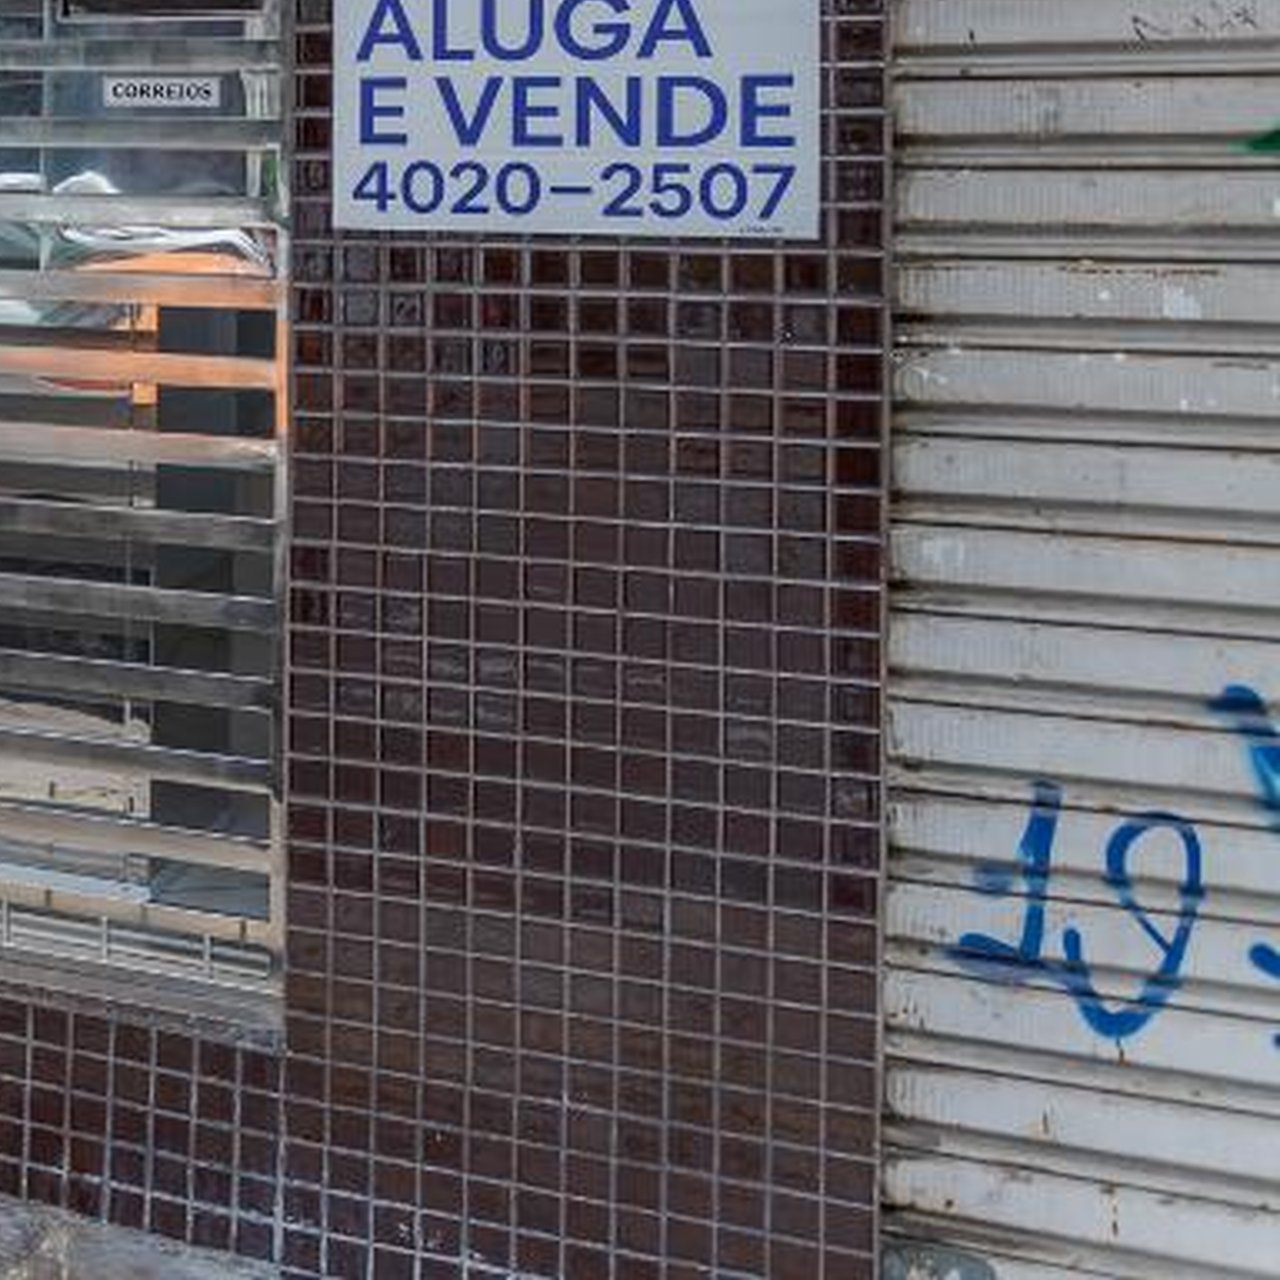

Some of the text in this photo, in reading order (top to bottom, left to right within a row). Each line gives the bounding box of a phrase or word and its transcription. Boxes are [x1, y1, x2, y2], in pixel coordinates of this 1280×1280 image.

[111, 81, 213, 101] CORREIOS
[358, 73, 797, 149] E VENDE
[351, 160, 798, 221] 4020-2507
